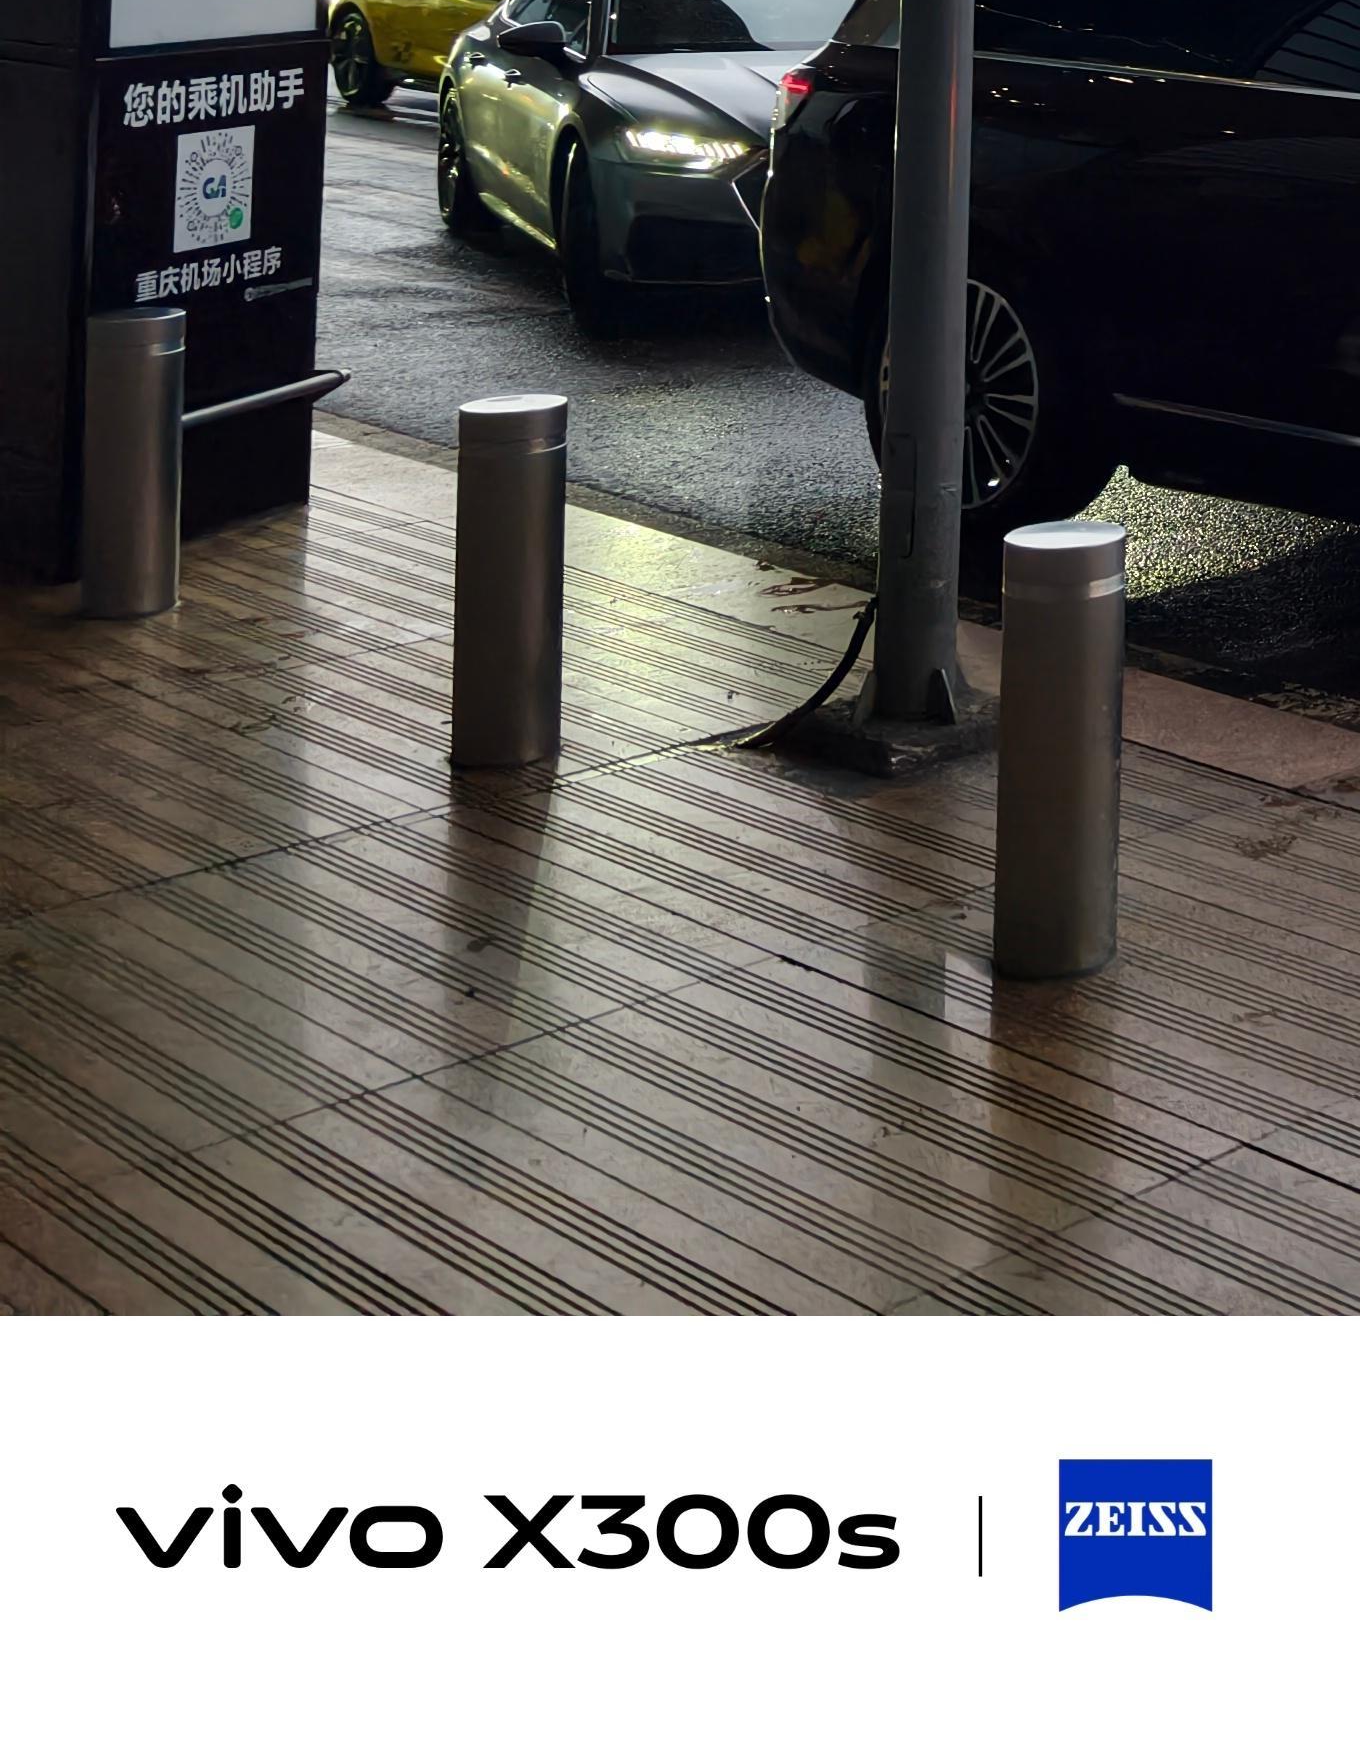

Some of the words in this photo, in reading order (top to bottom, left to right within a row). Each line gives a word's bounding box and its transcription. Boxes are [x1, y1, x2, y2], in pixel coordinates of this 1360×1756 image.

[123, 67, 305, 127] 您的乘机助手
[135, 245, 283, 303] 重庆机场小程序
